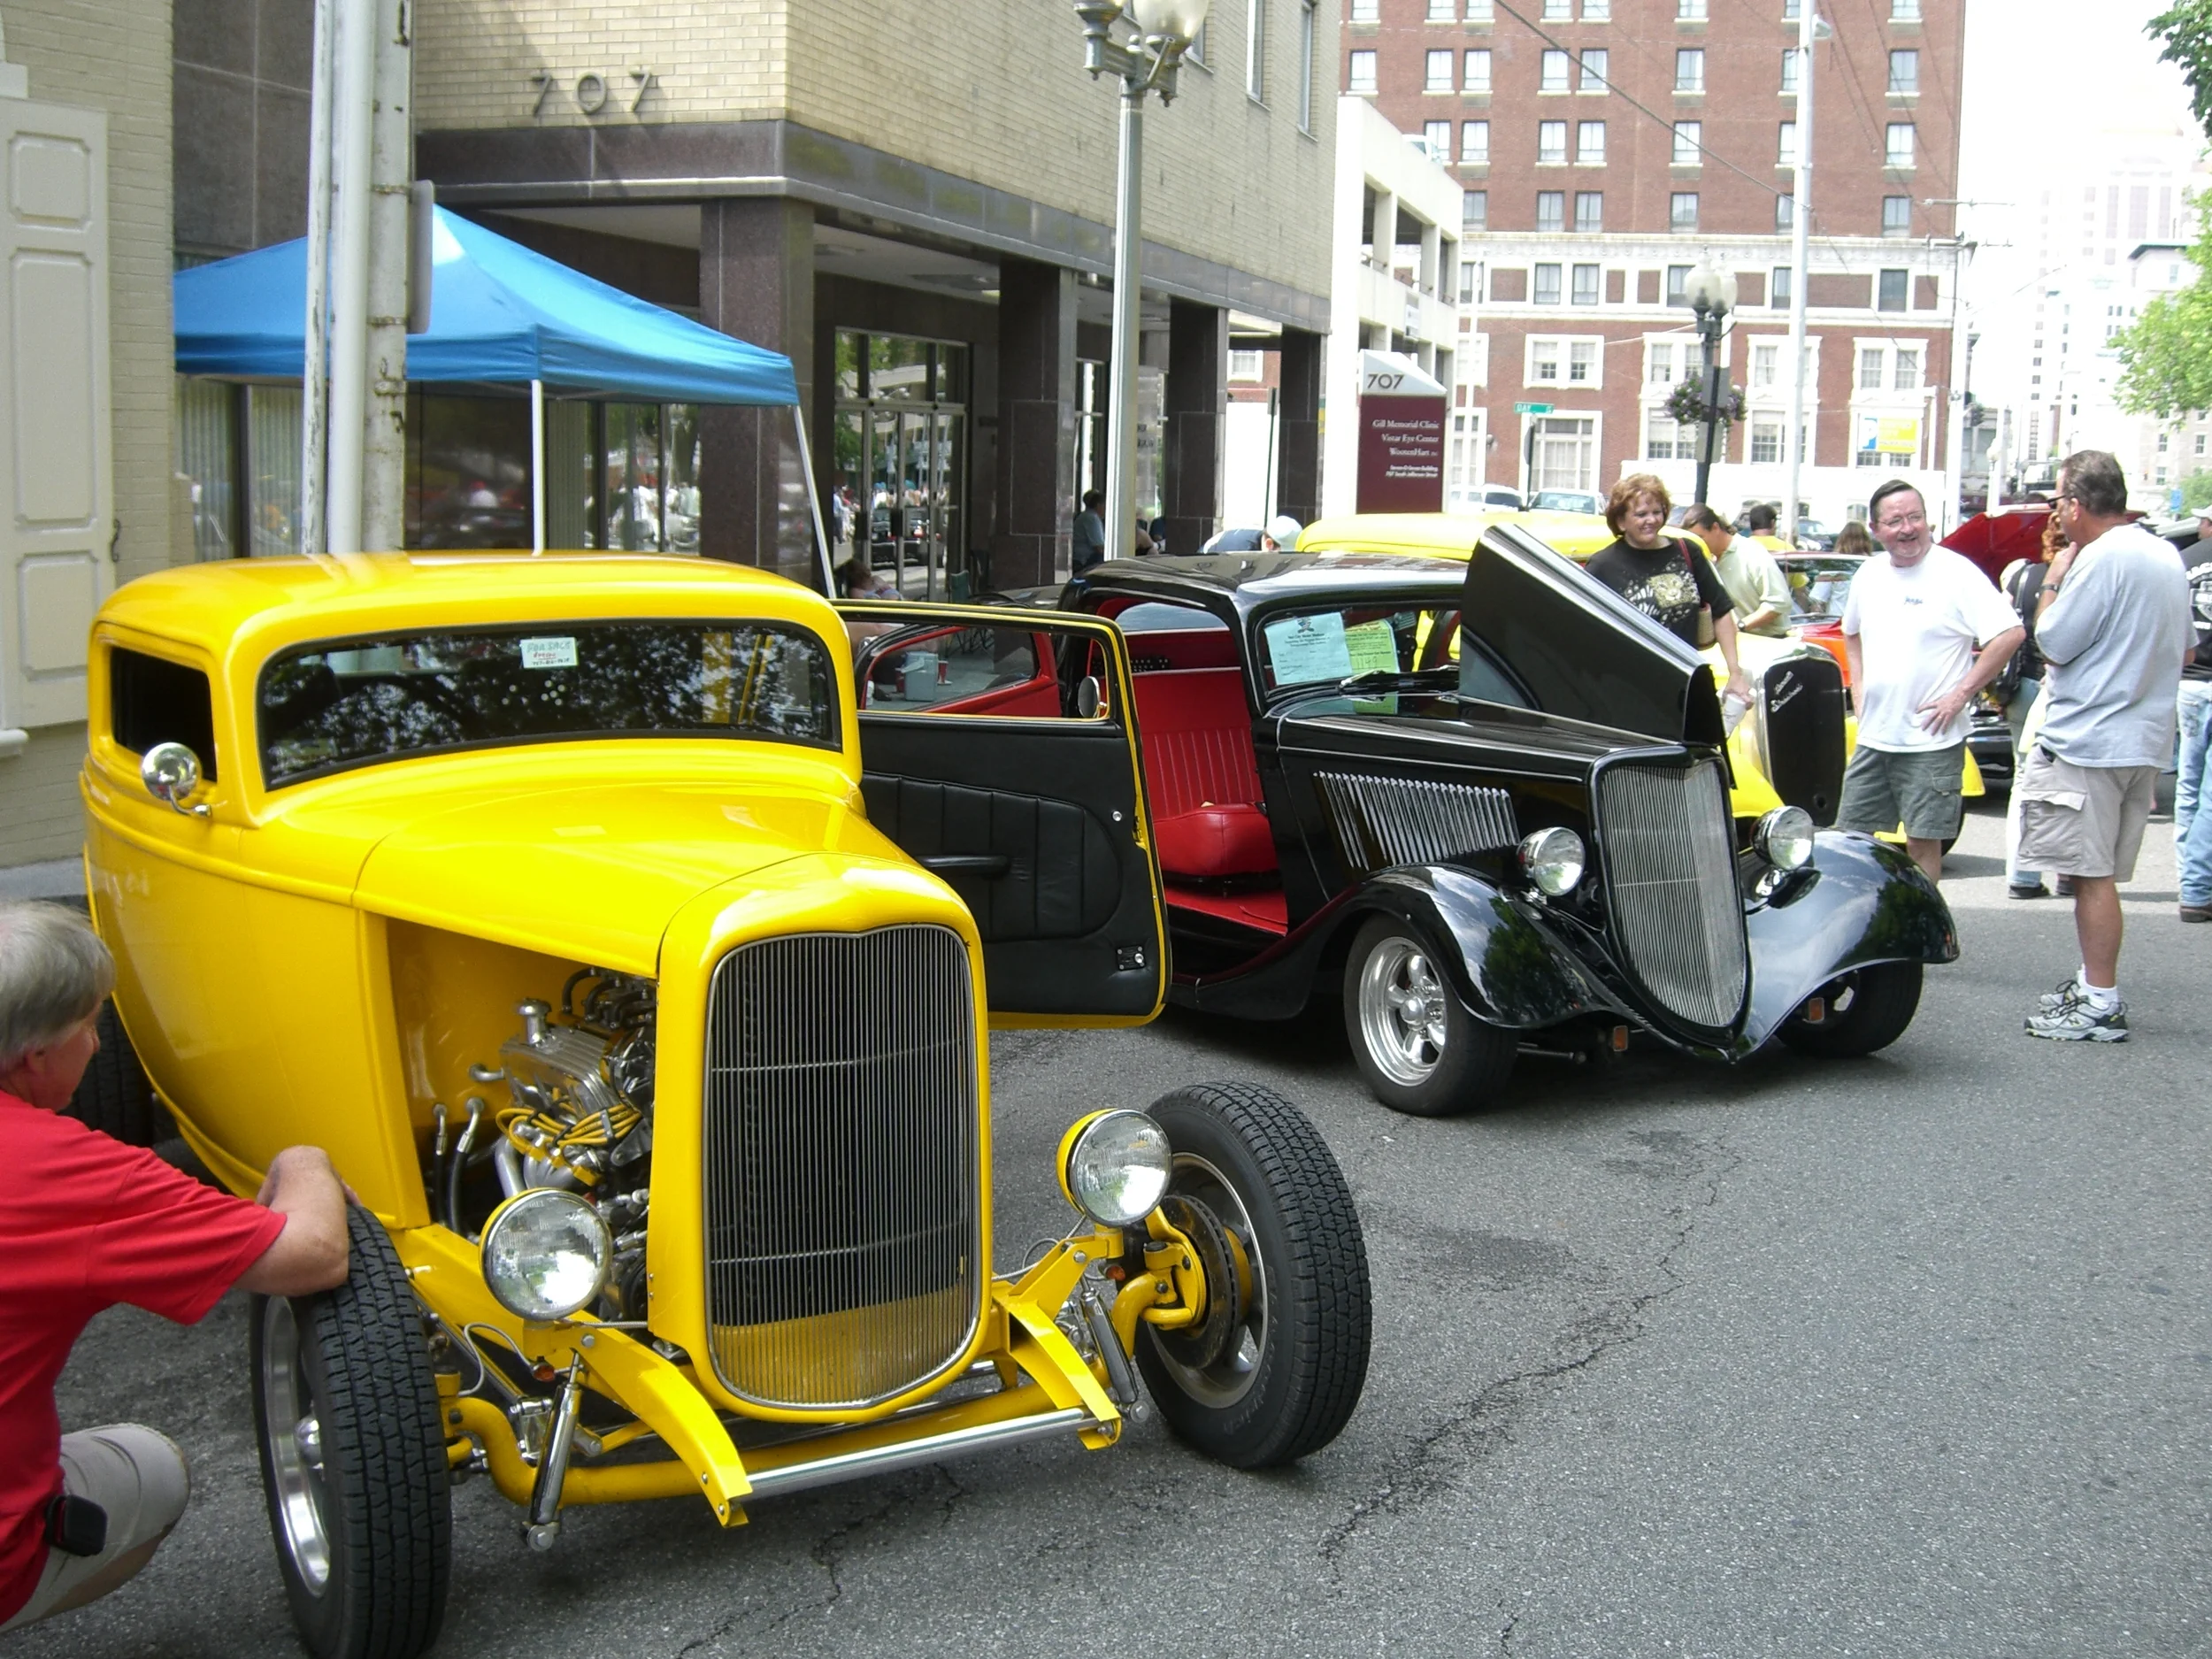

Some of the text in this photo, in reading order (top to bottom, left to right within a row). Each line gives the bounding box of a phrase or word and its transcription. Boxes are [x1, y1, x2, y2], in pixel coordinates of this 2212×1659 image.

[531, 67, 653, 118] 707
[1367, 373, 1405, 389] 707
[1372, 419, 1440, 429] Gill Memorial Clinic
[1402, 434, 1415, 443] Eye
[1416, 434, 1440, 443] Center
